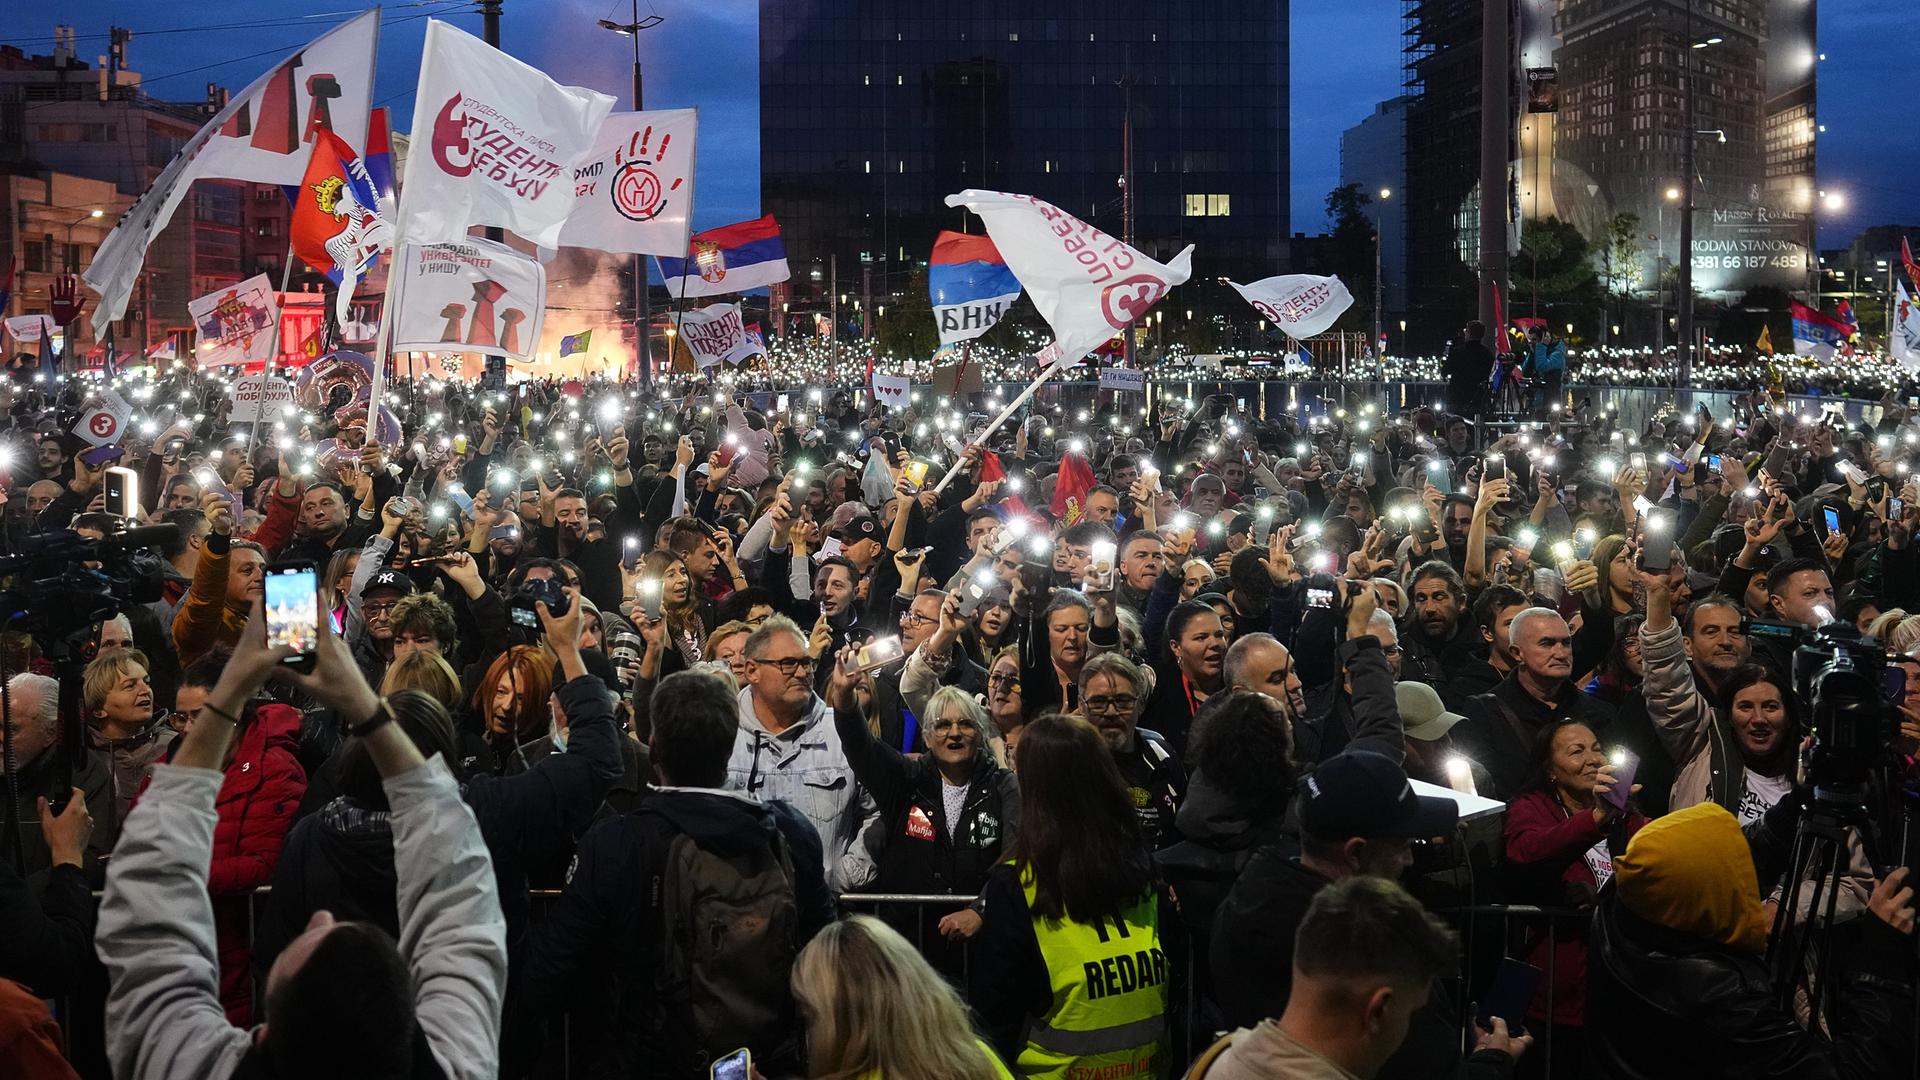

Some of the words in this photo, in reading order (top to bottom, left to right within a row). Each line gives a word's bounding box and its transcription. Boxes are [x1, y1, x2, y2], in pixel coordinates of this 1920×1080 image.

[1691, 240, 1738, 254] RODAJA
[1740, 240, 1798, 252] STANOVA
[1722, 256, 1741, 269] 66
[1744, 256, 1767, 269] 187
[1770, 256, 1798, 268] 485
[237, 381, 288, 391] СТУЕНТИ
[1083, 947, 1166, 1001] REDAR
